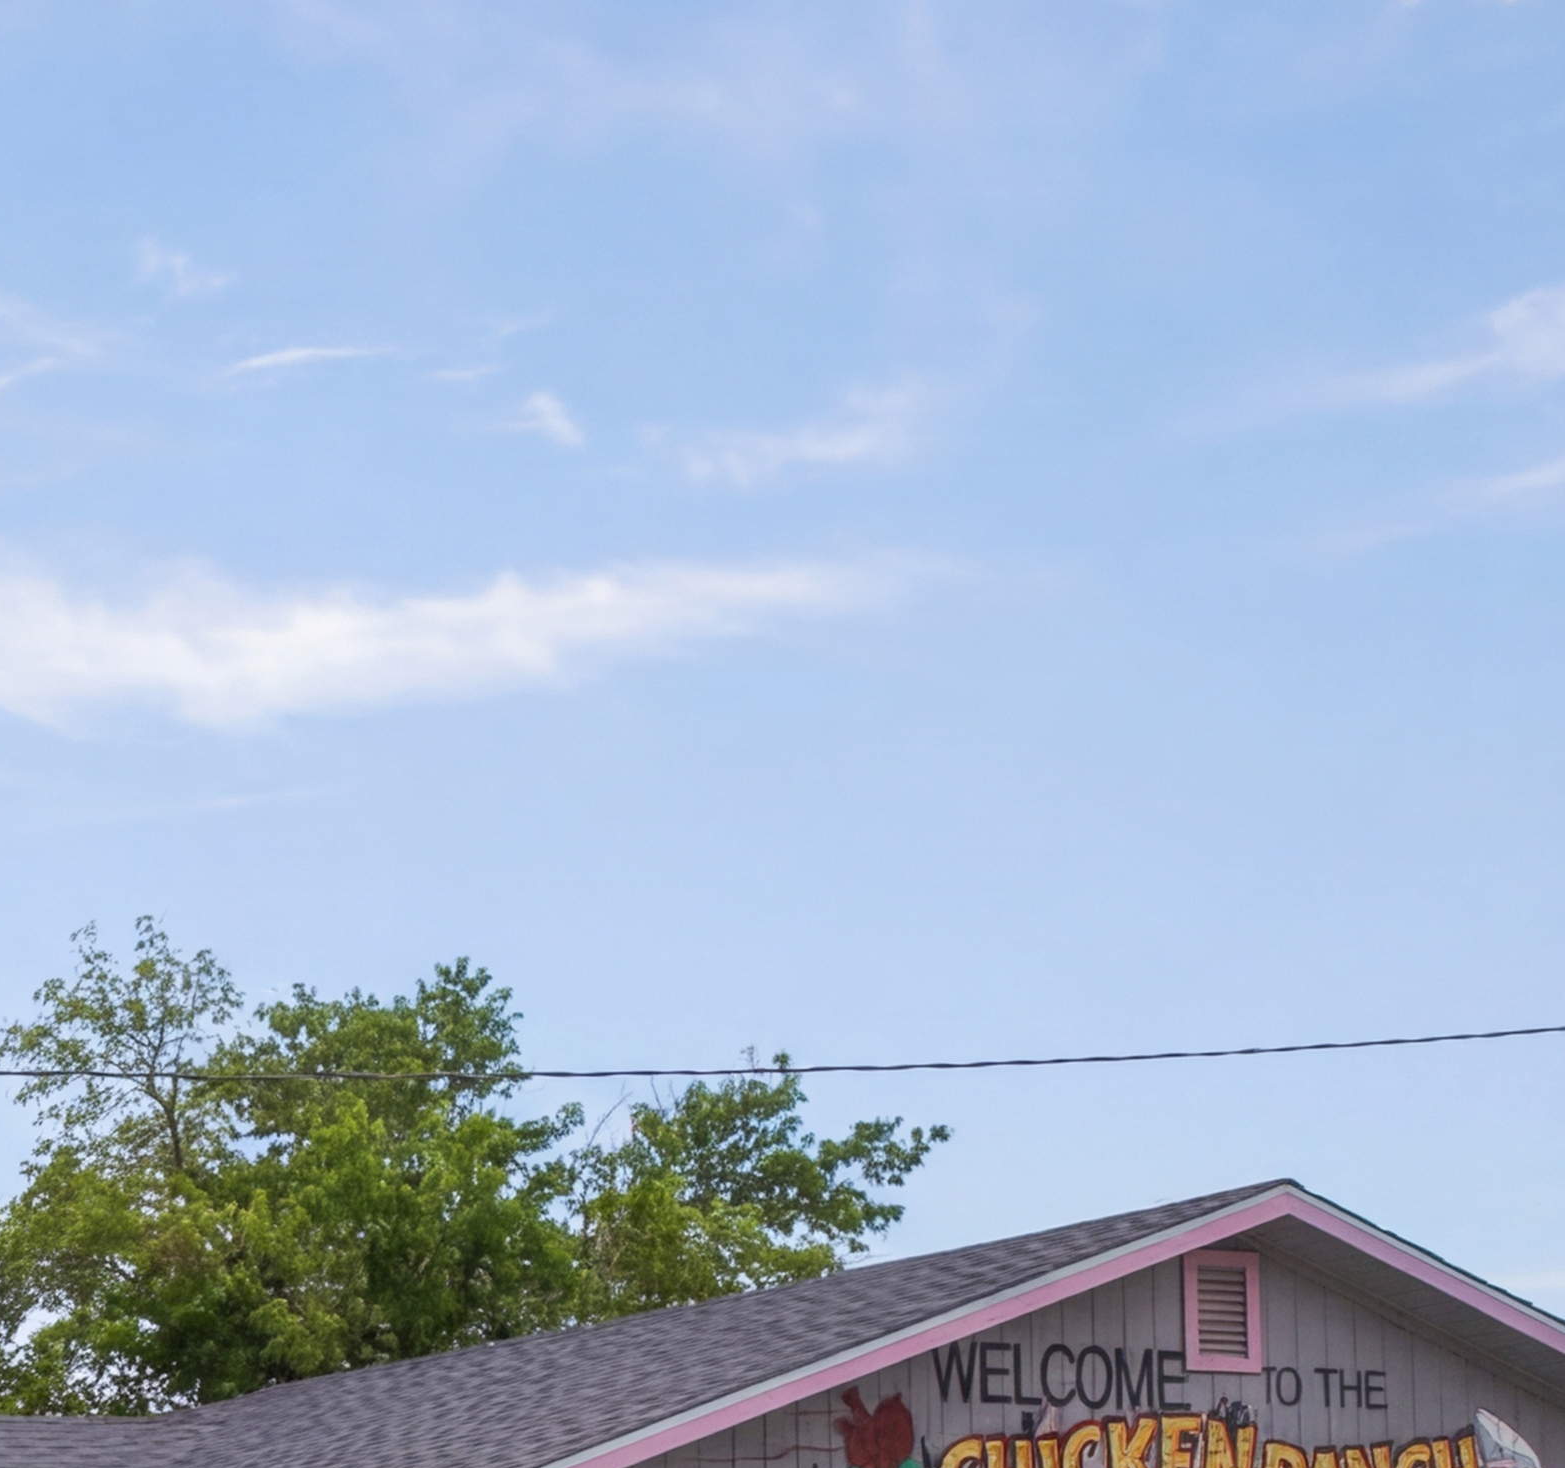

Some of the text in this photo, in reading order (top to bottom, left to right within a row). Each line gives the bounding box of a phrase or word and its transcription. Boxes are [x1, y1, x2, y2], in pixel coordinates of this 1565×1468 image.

[933, 1342, 1389, 1411] WELCOME TO THE
